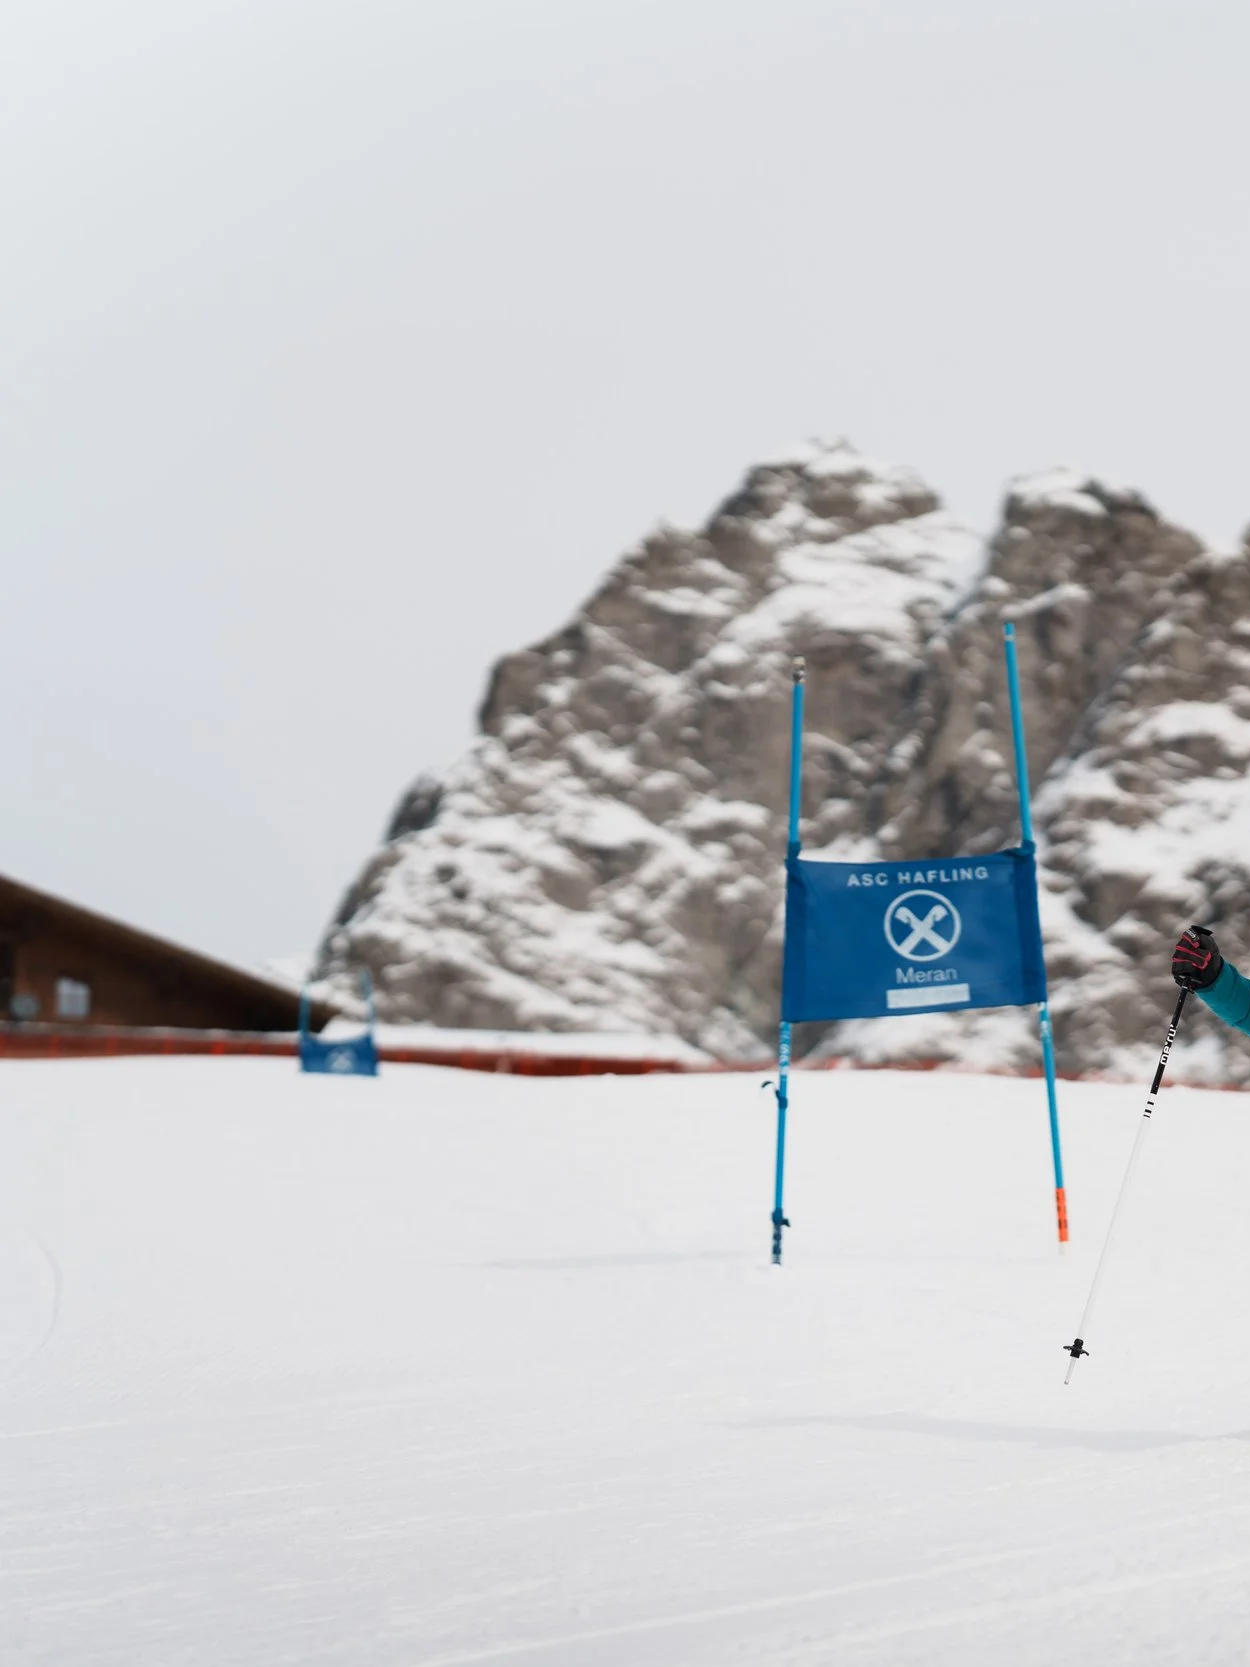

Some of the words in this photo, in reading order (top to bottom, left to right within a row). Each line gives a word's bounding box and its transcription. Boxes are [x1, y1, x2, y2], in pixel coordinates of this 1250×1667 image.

[847, 872, 889, 887] ASC
[898, 866, 989, 884] HAFLING
[896, 967, 958, 984] Meran
